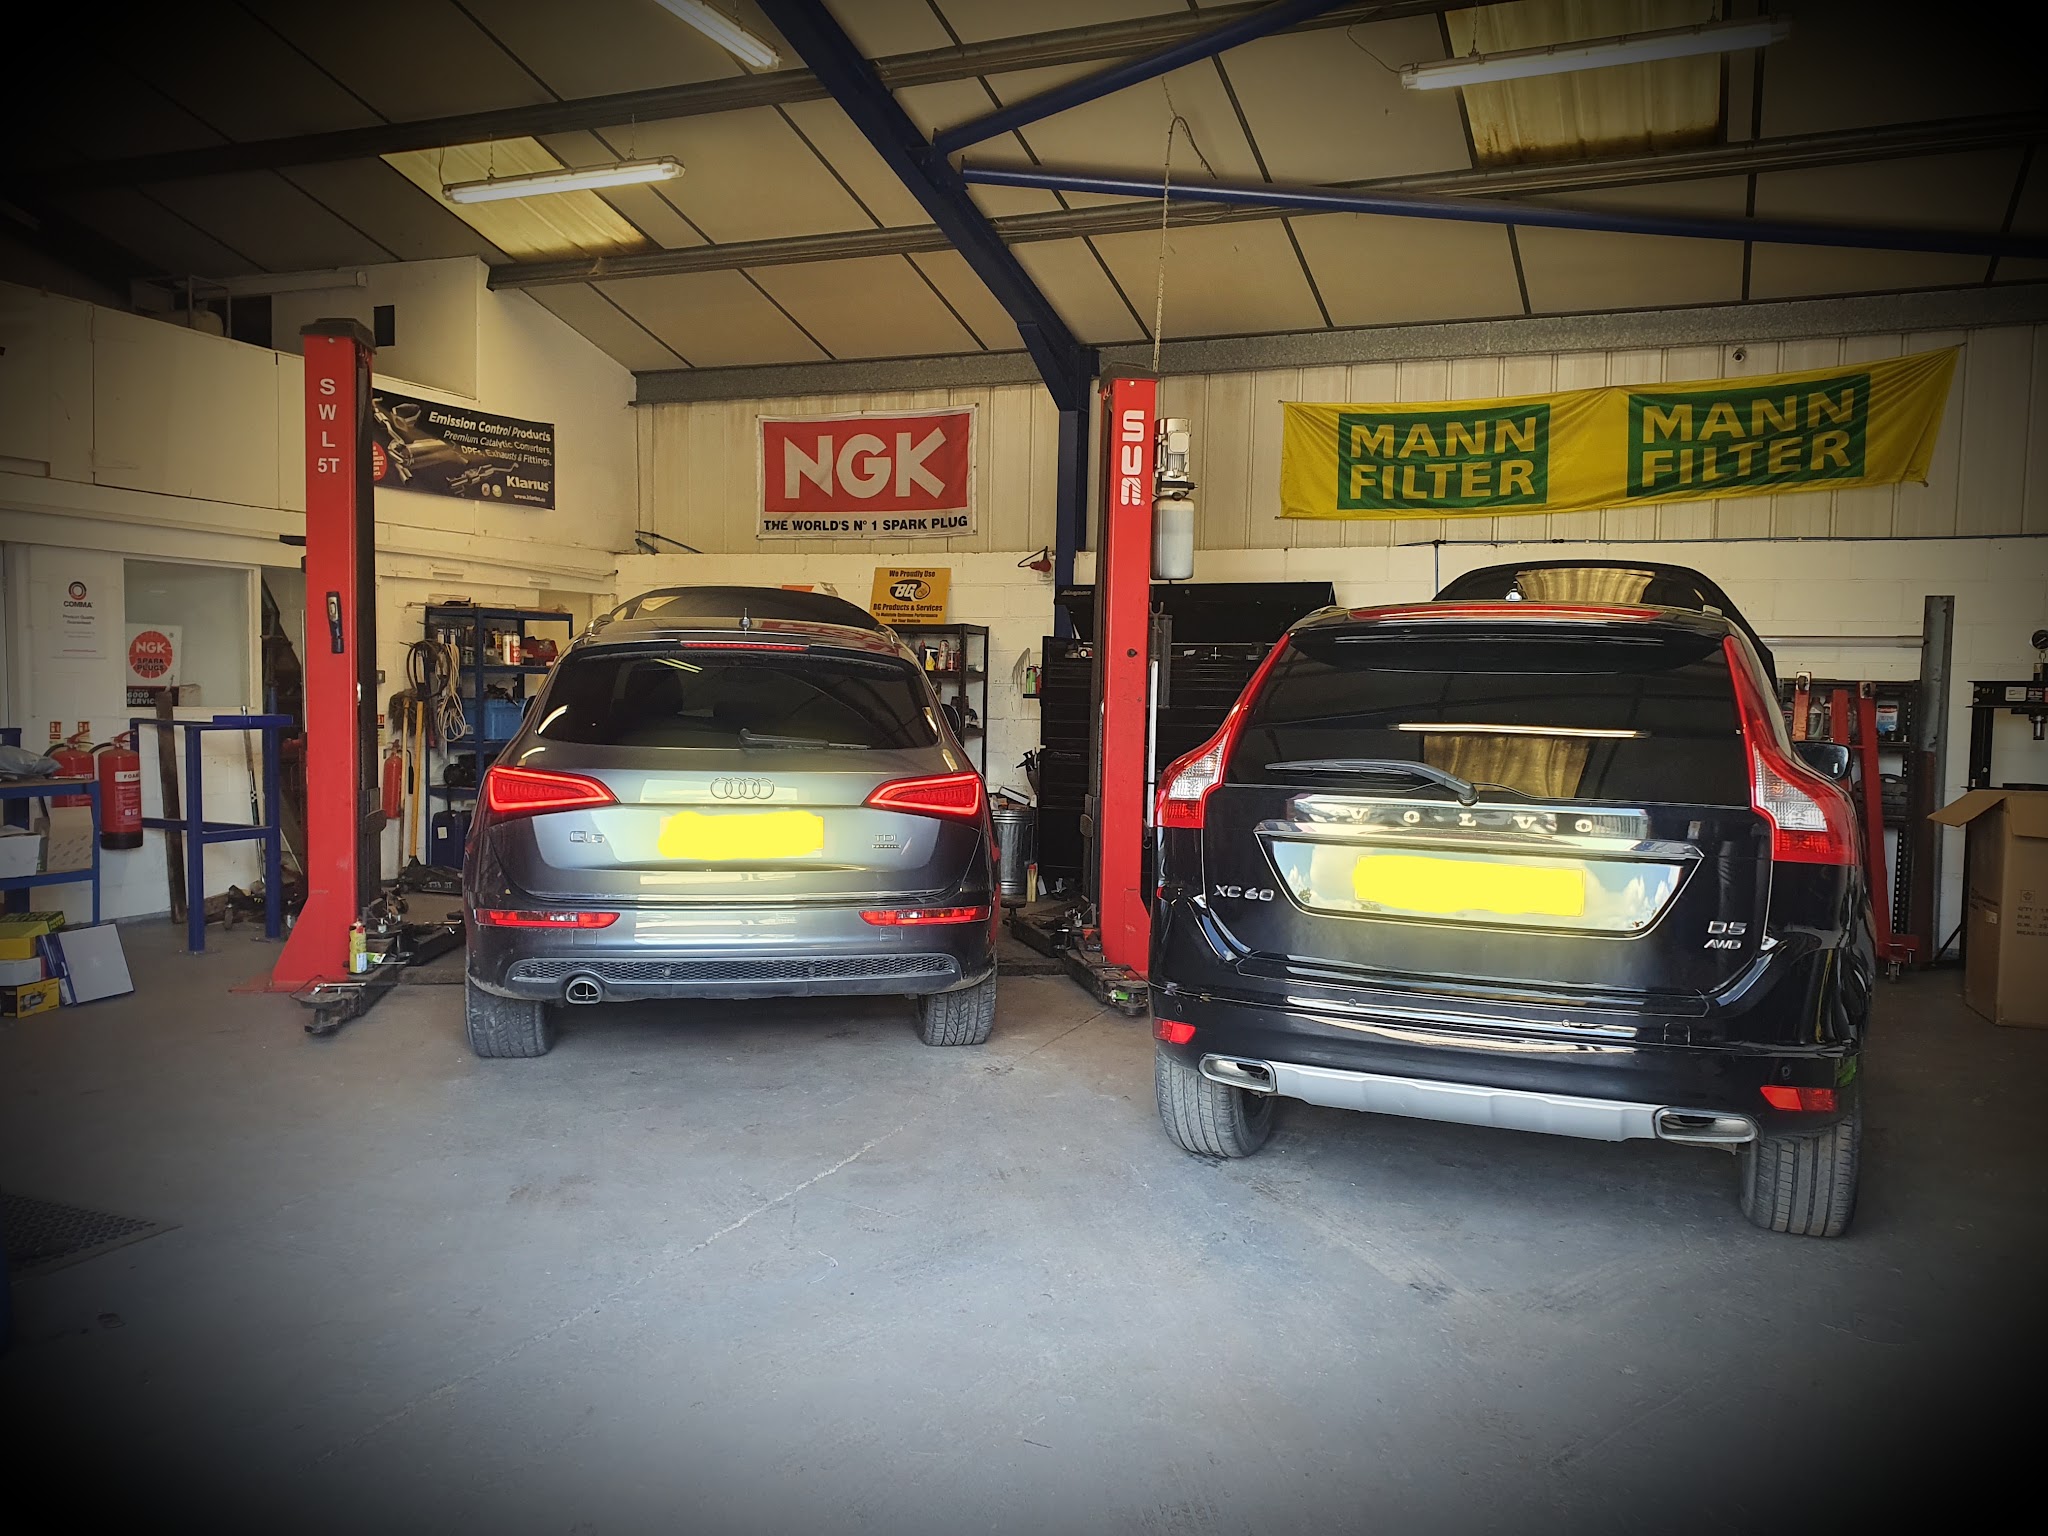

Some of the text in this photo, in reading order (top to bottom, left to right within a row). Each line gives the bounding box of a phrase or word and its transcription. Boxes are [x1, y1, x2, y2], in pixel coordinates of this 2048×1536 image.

[1642, 388, 1855, 444] MANN
[428, 411, 551, 442] Emission Control Products
[443, 430, 478, 444] Premium
[480, 437, 513, 449] Catalytic
[1351, 416, 1537, 459] MANN
[485, 449, 517, 461] Exhausts
[784, 426, 947, 499] NGK
[1642, 429, 1852, 488] FILTER
[317, 458, 340, 473] 5T
[506, 475, 549, 492] Klarius
[1350, 459, 1536, 500] FILTER
[764, 520, 788, 531] THE
[792, 520, 849, 531] WORLD'S
[871, 520, 877, 531] 1
[883, 518, 928, 531] SPARK
[931, 515, 968, 529] PLUG
[900, 570, 924, 578] Proudly
[891, 583, 918, 601] BG
[63, 600, 93, 608] COMMA
[873, 603, 882, 611] BG
[882, 603, 909, 611] Products
[916, 604, 943, 612] Services
[135, 641, 166, 654] NGK
[1349, 807, 1593, 833] VOLVO
[570, 830, 605, 843] Q5
[1707, 920, 1748, 935] D5
[1703, 939, 1742, 949] AWD
